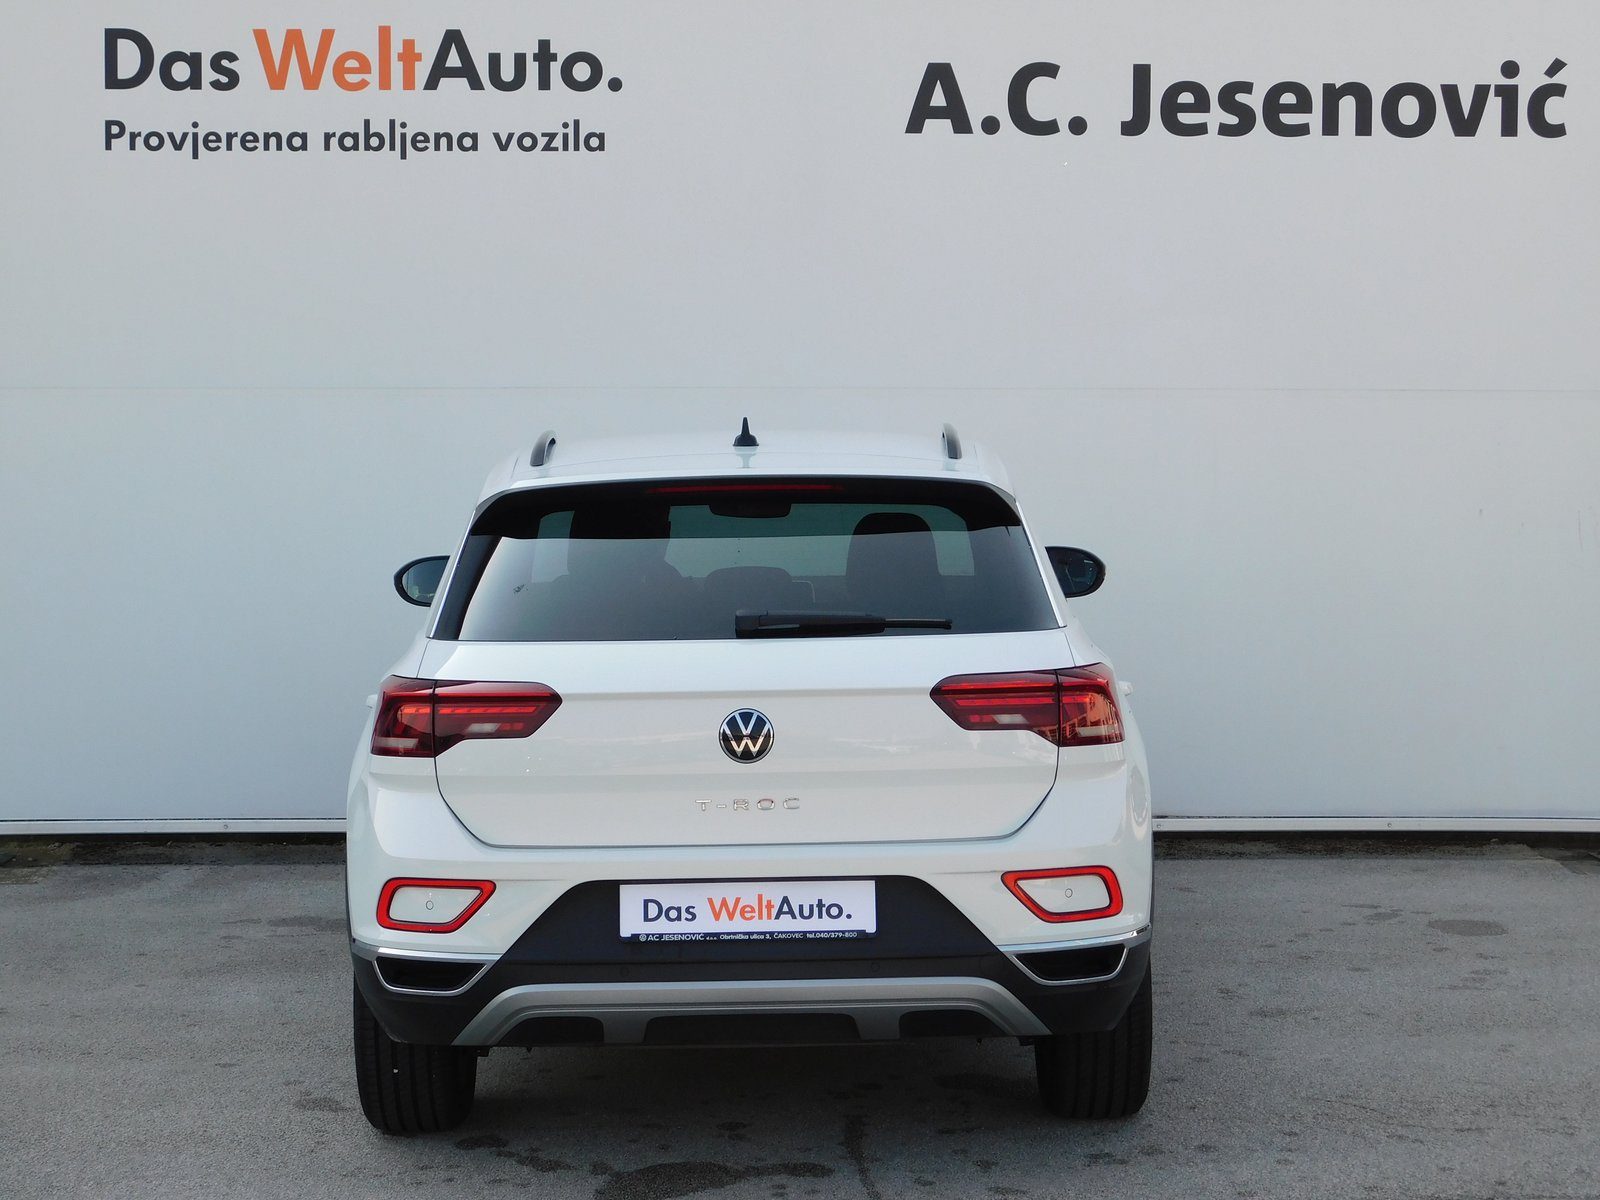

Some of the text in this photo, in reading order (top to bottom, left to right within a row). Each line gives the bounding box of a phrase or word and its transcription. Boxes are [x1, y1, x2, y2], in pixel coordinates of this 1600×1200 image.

[104, 26, 623, 92] Das WeltAuto.
[905, 57, 1568, 139] A.C. Jesenović
[104, 118, 606, 161] Provjerena rabljena vozila
[695, 798, 801, 812] T-ROC
[642, 893, 853, 923] Das WeltAuto.
[661, 933, 705, 941] JESENOVIĆ
[773, 931, 804, 939] ČAKOVEC
